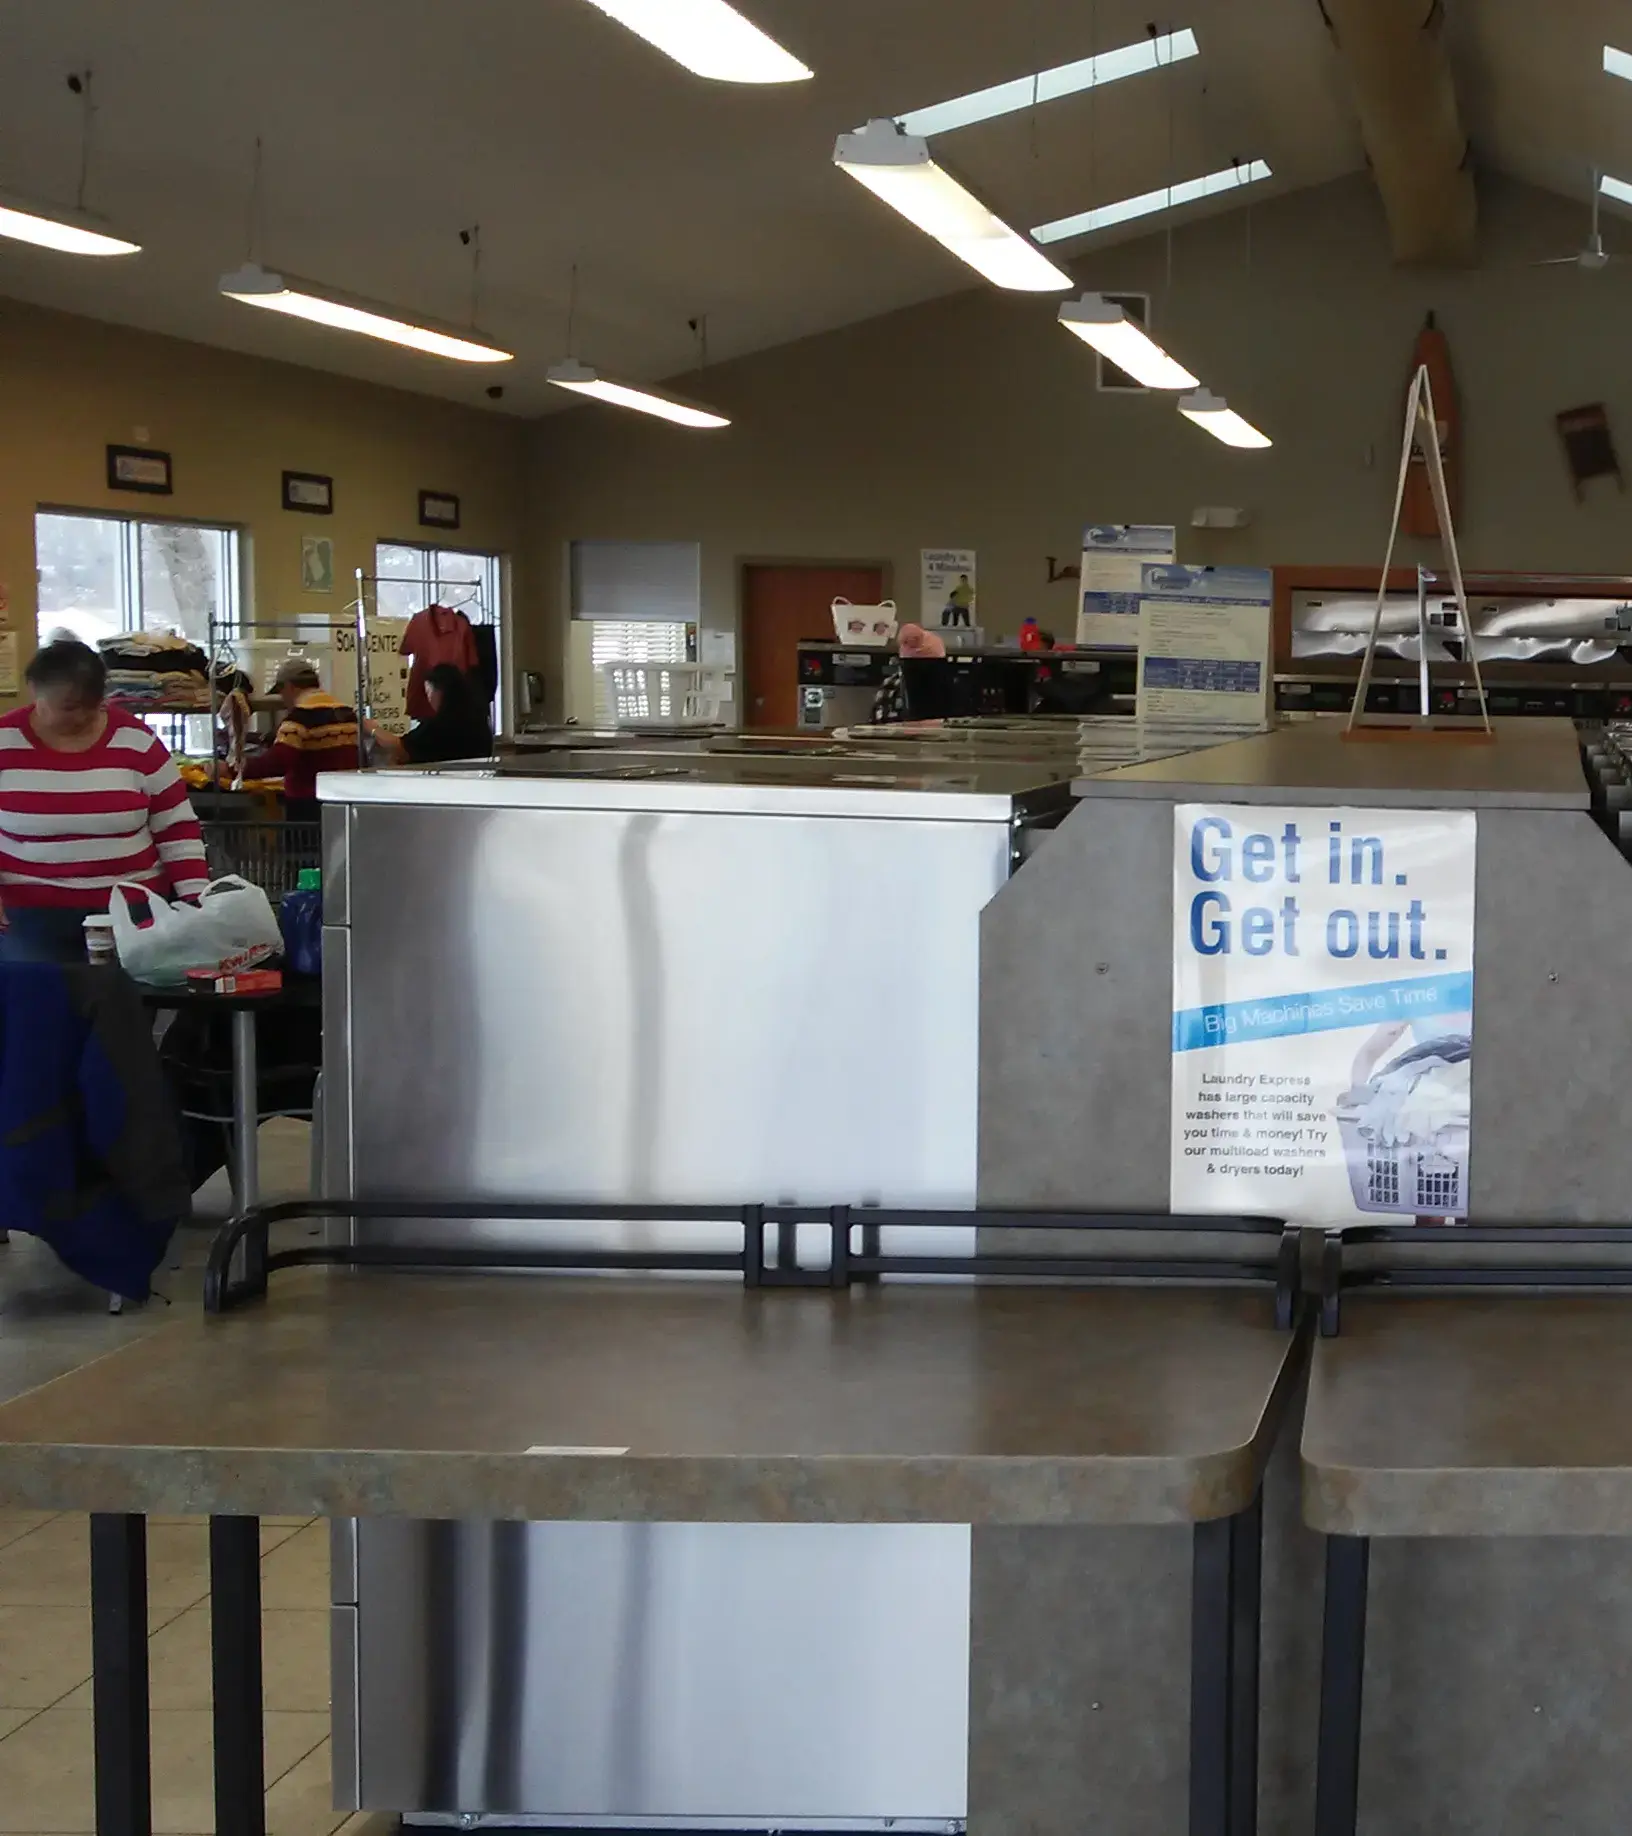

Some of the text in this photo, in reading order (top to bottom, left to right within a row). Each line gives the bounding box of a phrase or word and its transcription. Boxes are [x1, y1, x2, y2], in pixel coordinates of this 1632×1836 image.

[1190, 816, 1408, 886] Get in.
[1189, 890, 1448, 961] Get out.
[1203, 984, 1438, 1034] Big Machines Save Time
[1202, 1073, 1311, 1087] Laundry Express
[1198, 1091, 1315, 1106] has large capacity
[1185, 1109, 1327, 1122] washers that will save
[1183, 1127, 1328, 1143] you time & money! Try
[1184, 1145, 1326, 1157] our multiload washers
[1206, 1163, 1304, 1178] & dryers today!
